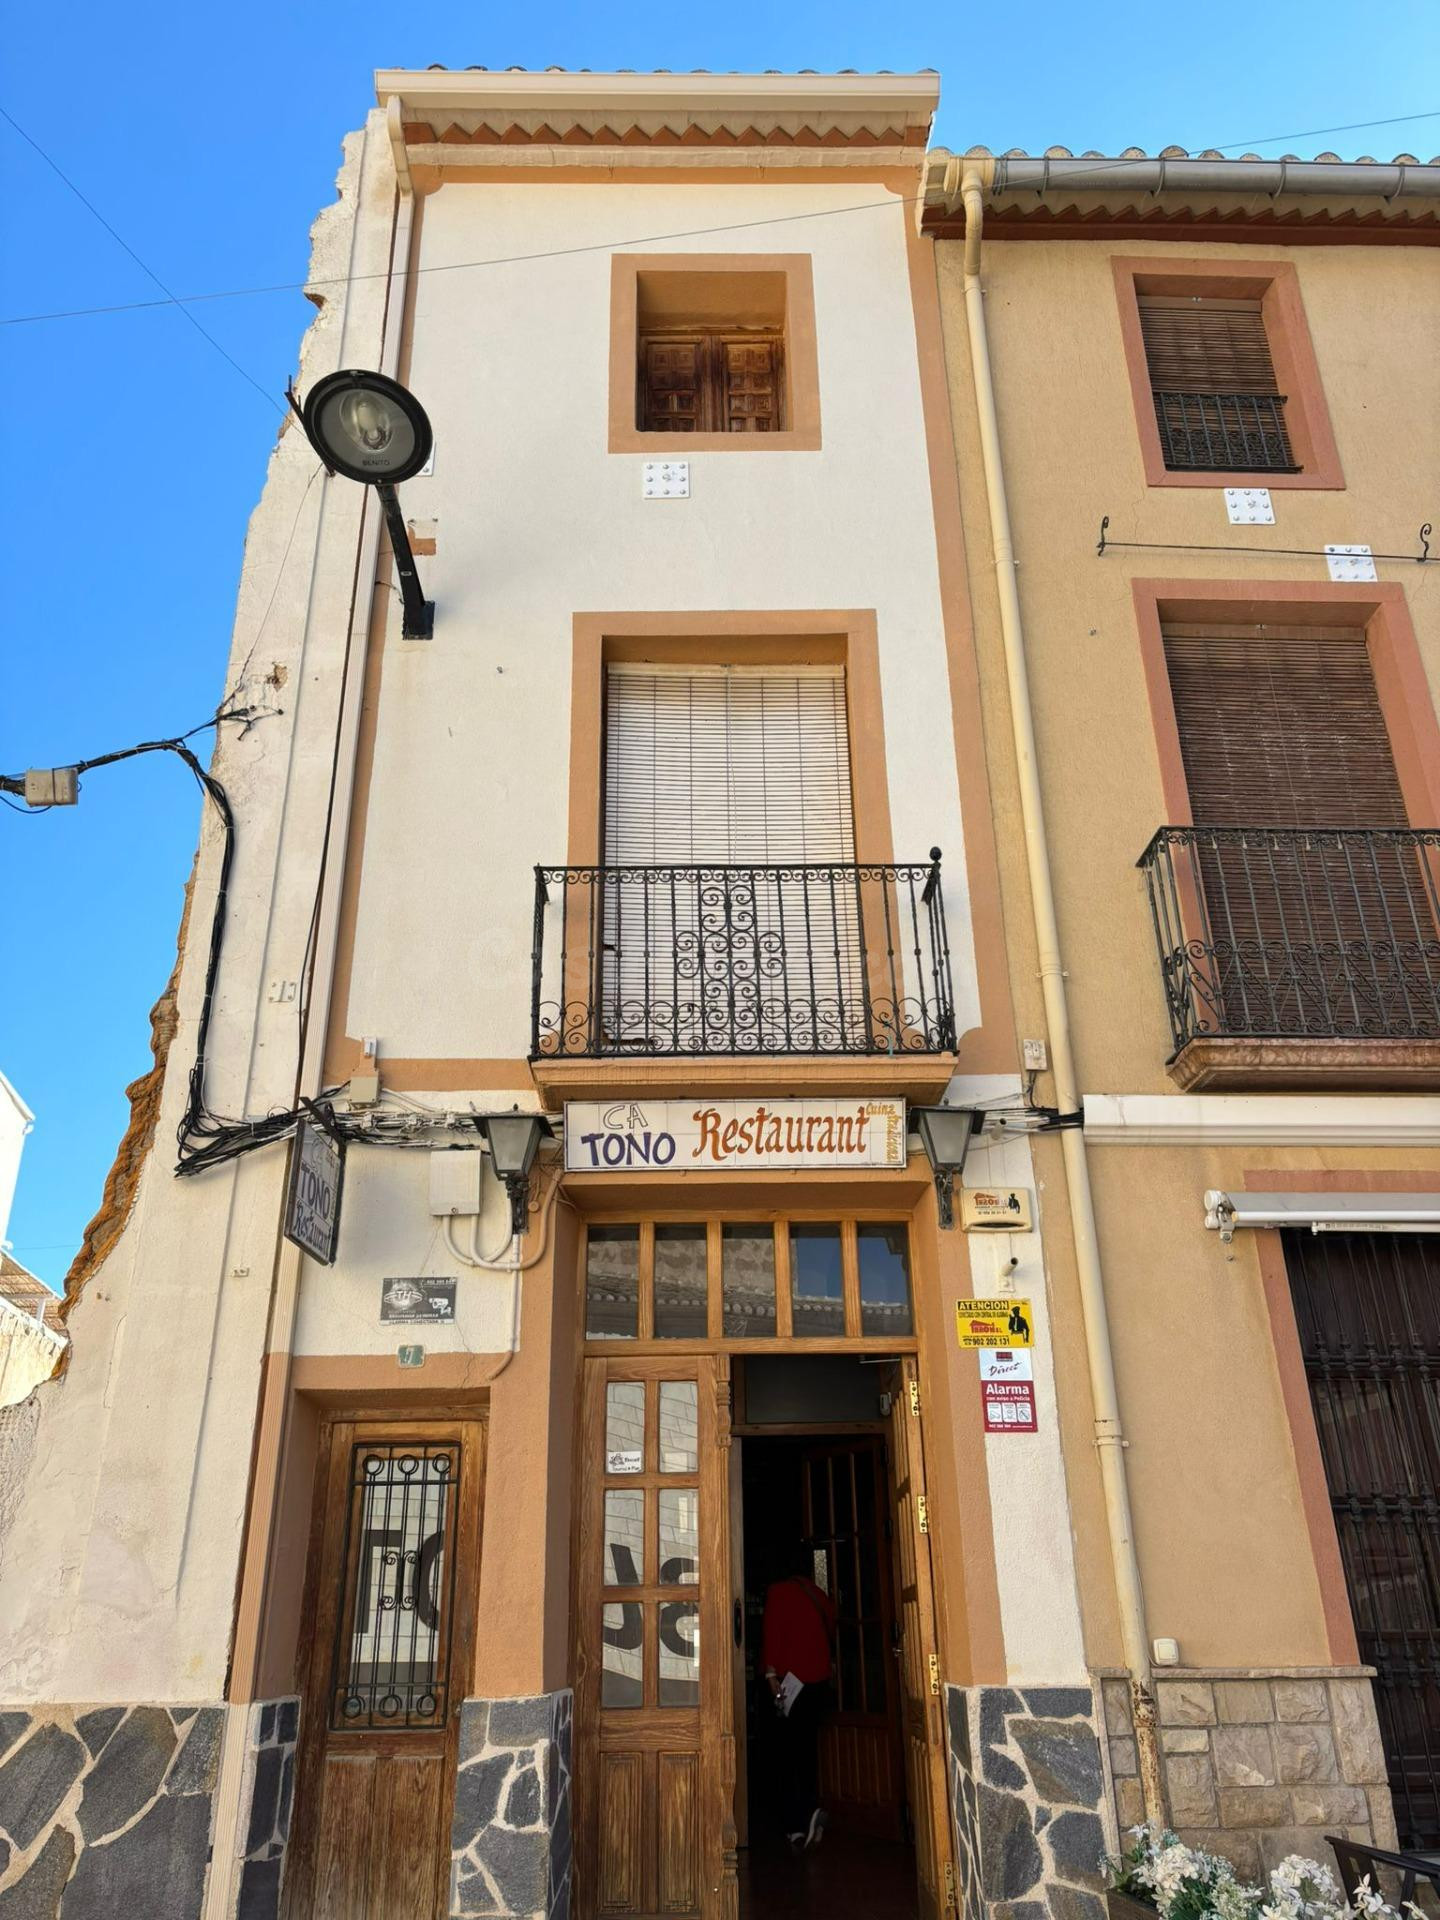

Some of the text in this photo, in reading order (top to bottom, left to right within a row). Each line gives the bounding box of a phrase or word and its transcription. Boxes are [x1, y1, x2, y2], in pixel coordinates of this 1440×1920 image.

[603, 1103, 648, 1130] CA
[692, 1106, 870, 1161] Restaurant
[581, 1132, 676, 1166] TONO
[301, 1162, 331, 1220] TONO
[959, 1301, 1008, 1310] ATENCION
[973, 1337, 1010, 1346] 902 202 131
[986, 1383, 1030, 1395] Alarma
